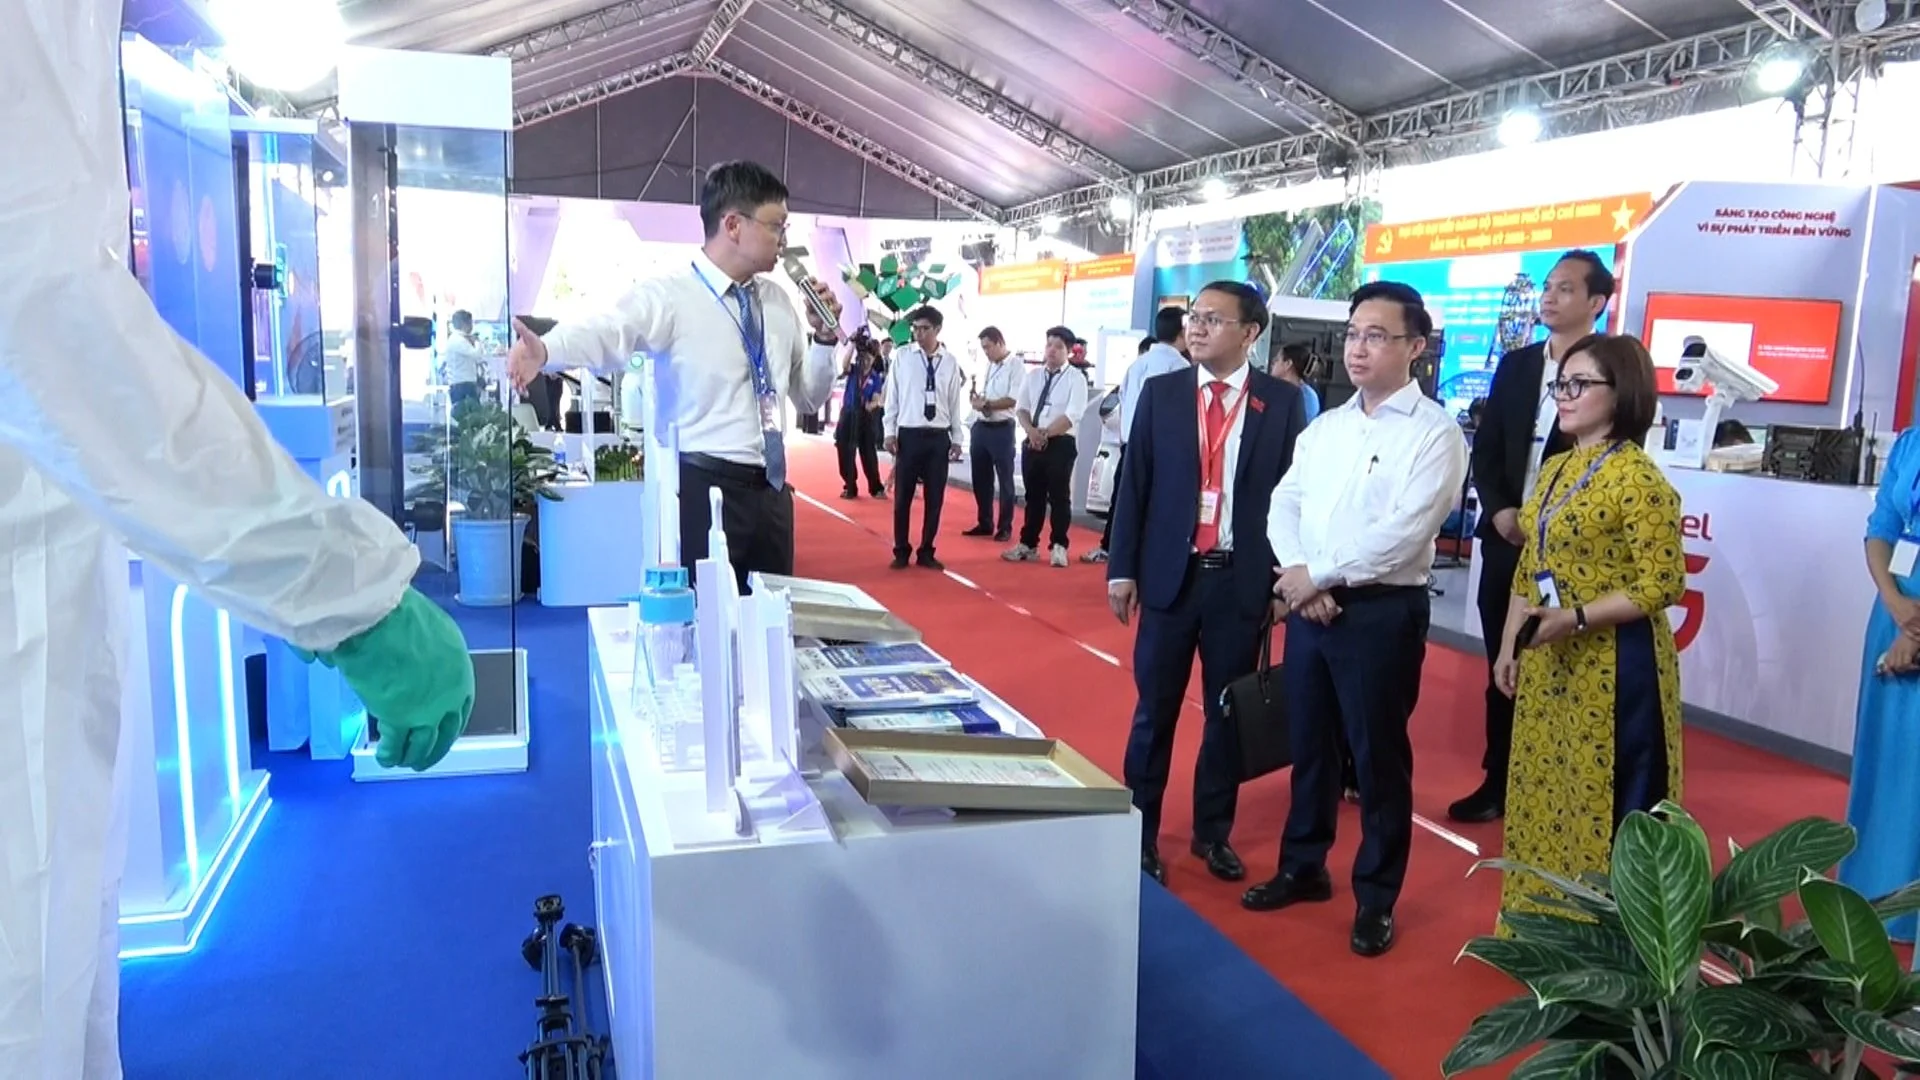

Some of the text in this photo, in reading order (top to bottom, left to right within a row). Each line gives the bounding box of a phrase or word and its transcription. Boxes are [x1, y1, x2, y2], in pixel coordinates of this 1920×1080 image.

[1715, 208, 1836, 223] SÁNG TẠO CÔNG NGHỆ
[1710, 223, 1726, 235] SỰ
[1727, 223, 1756, 234] PHÁT
